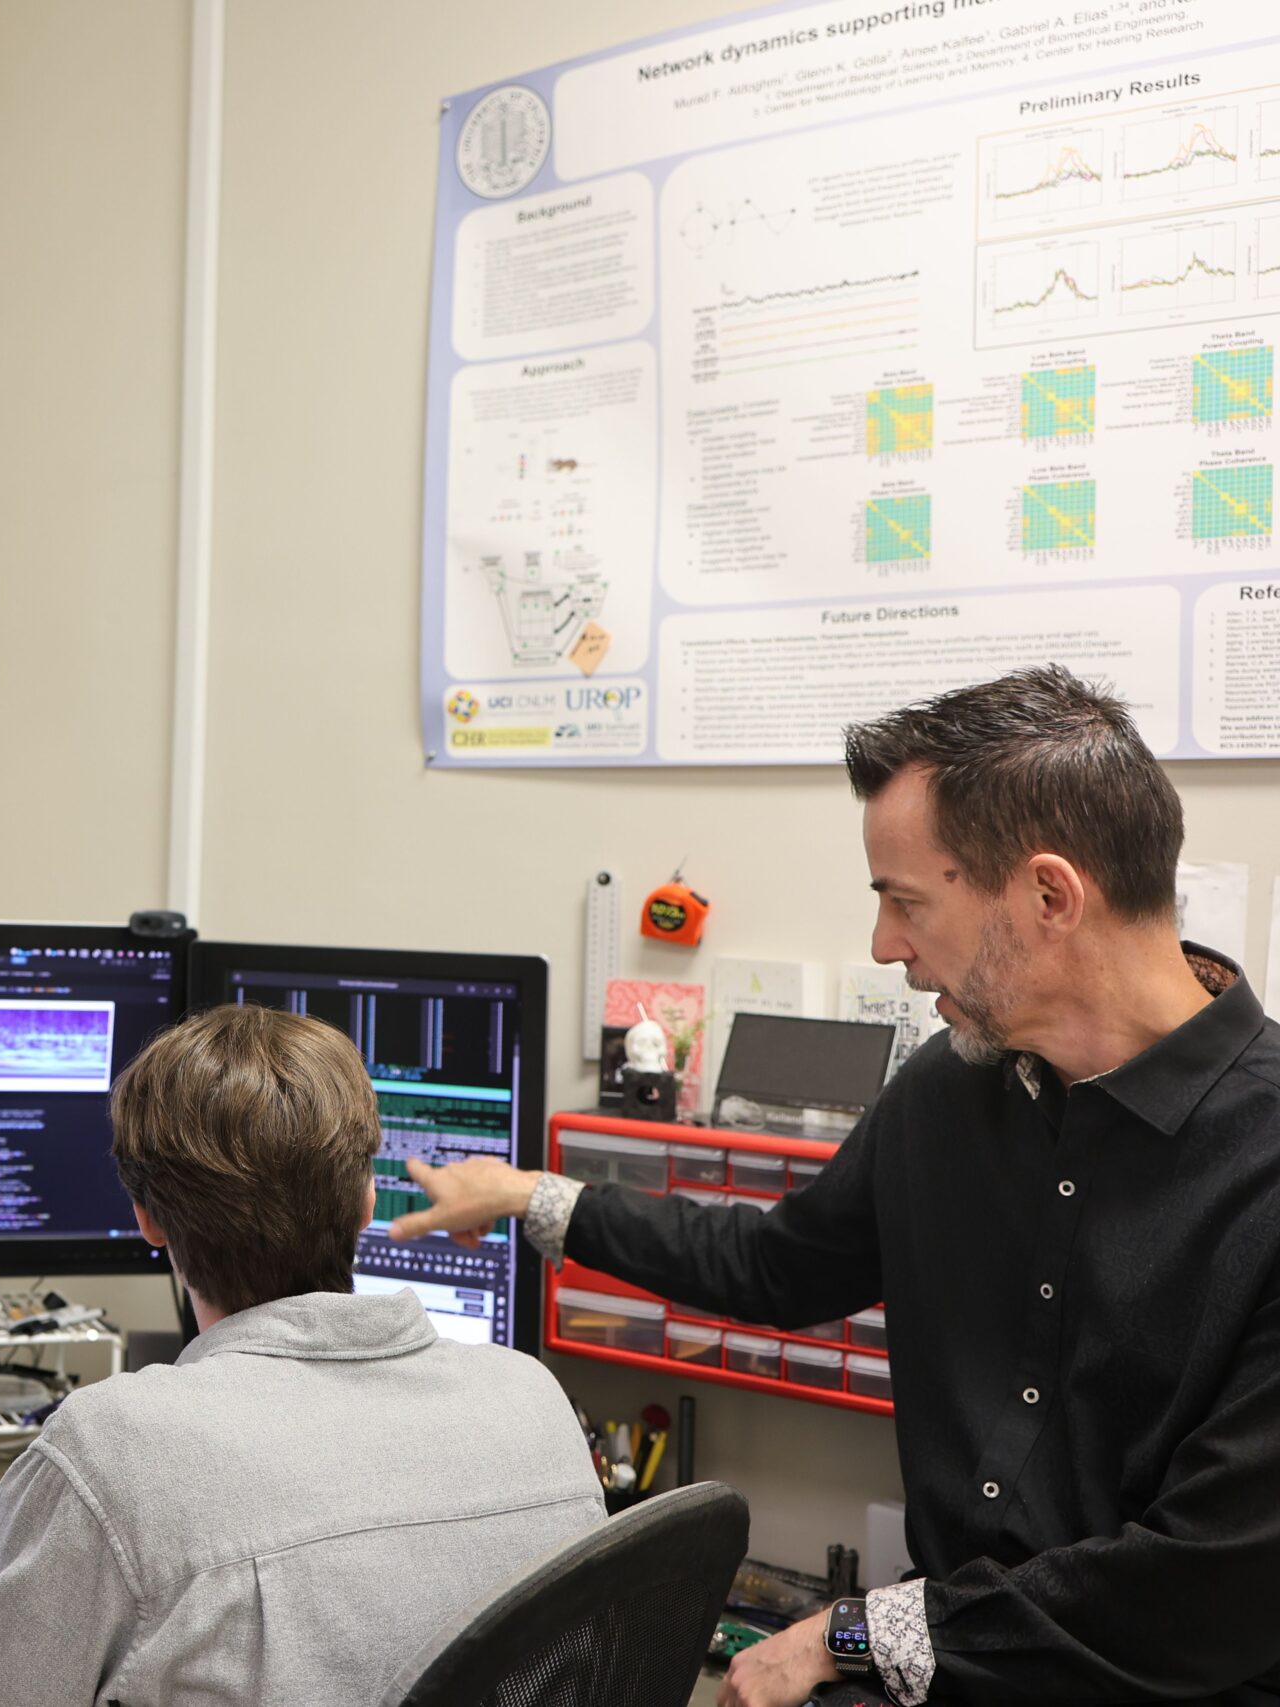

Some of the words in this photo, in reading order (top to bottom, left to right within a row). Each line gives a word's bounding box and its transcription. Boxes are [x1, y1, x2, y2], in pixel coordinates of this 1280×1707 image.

[999, 18, 1051, 41] Gabriel
[1035, 44, 1075, 61] Center
[1096, 30, 1144, 51] Hearing
[1146, 18, 1205, 40] Research
[1048, 23, 1111, 45] Biomedical
[636, 49, 715, 84] Network
[719, 26, 820, 64] dynamics
[826, 0, 946, 39] supporting
[1019, 85, 1124, 116] Preliminary
[1129, 71, 1202, 96] Results
[516, 196, 593, 225] Background
[1240, 585, 1280, 601] Refe
[821, 609, 872, 625] Future
[876, 603, 960, 622] Directions
[487, 696, 514, 709] UCI
[565, 686, 642, 711] UROP
[835, 1630, 868, 1641] 13:33
